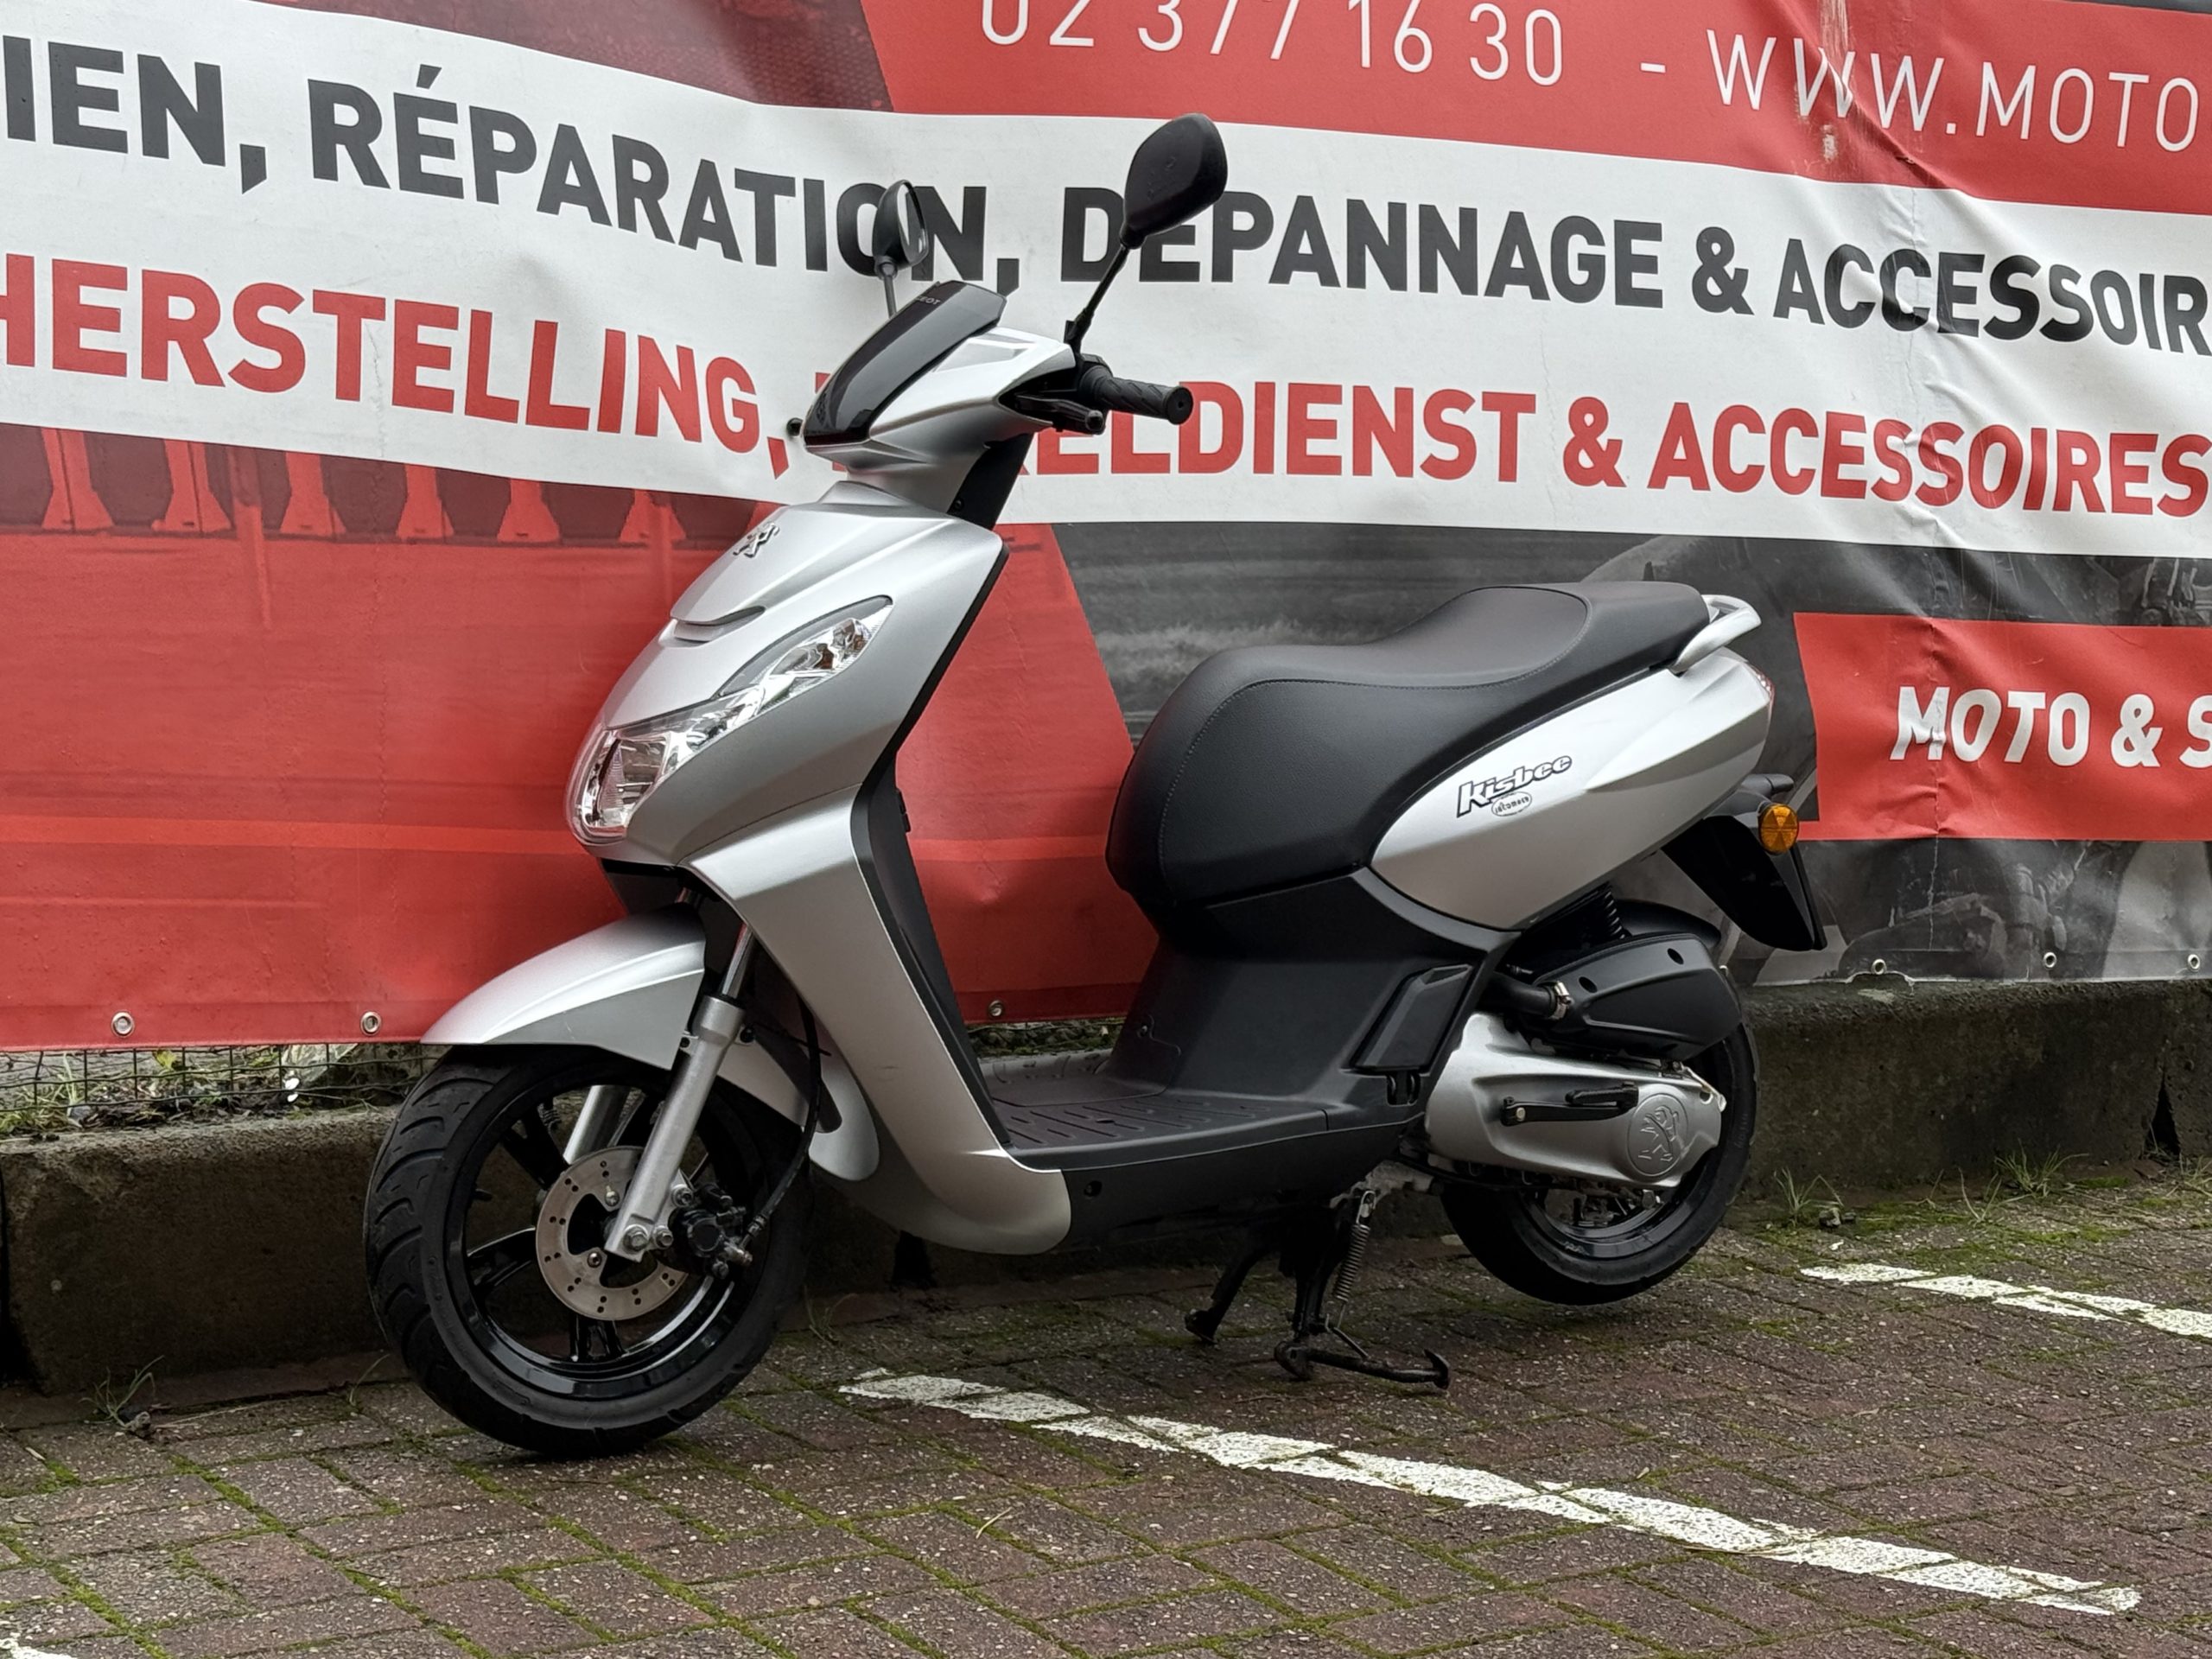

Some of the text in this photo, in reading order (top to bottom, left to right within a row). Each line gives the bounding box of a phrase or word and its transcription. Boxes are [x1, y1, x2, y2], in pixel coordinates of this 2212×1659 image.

[982, 0, 1094, 46] 02
[1348, 0, 1433, 73] 16
[1469, 3, 1562, 86] 30
[1707, 29, 2199, 152] WWW.MOTO
[3, 35, 267, 194] IEN,
[308, 64, 1020, 300] RÉPARATION,
[1691, 226, 1755, 315] &
[1772, 238, 2212, 357] ACCESSOIR
[815, 372, 1536, 483] ELDIENST
[1562, 397, 1627, 489] &
[1648, 402, 2212, 518] ACCESSOIRES
[1890, 686, 2212, 768] MOTO & S
